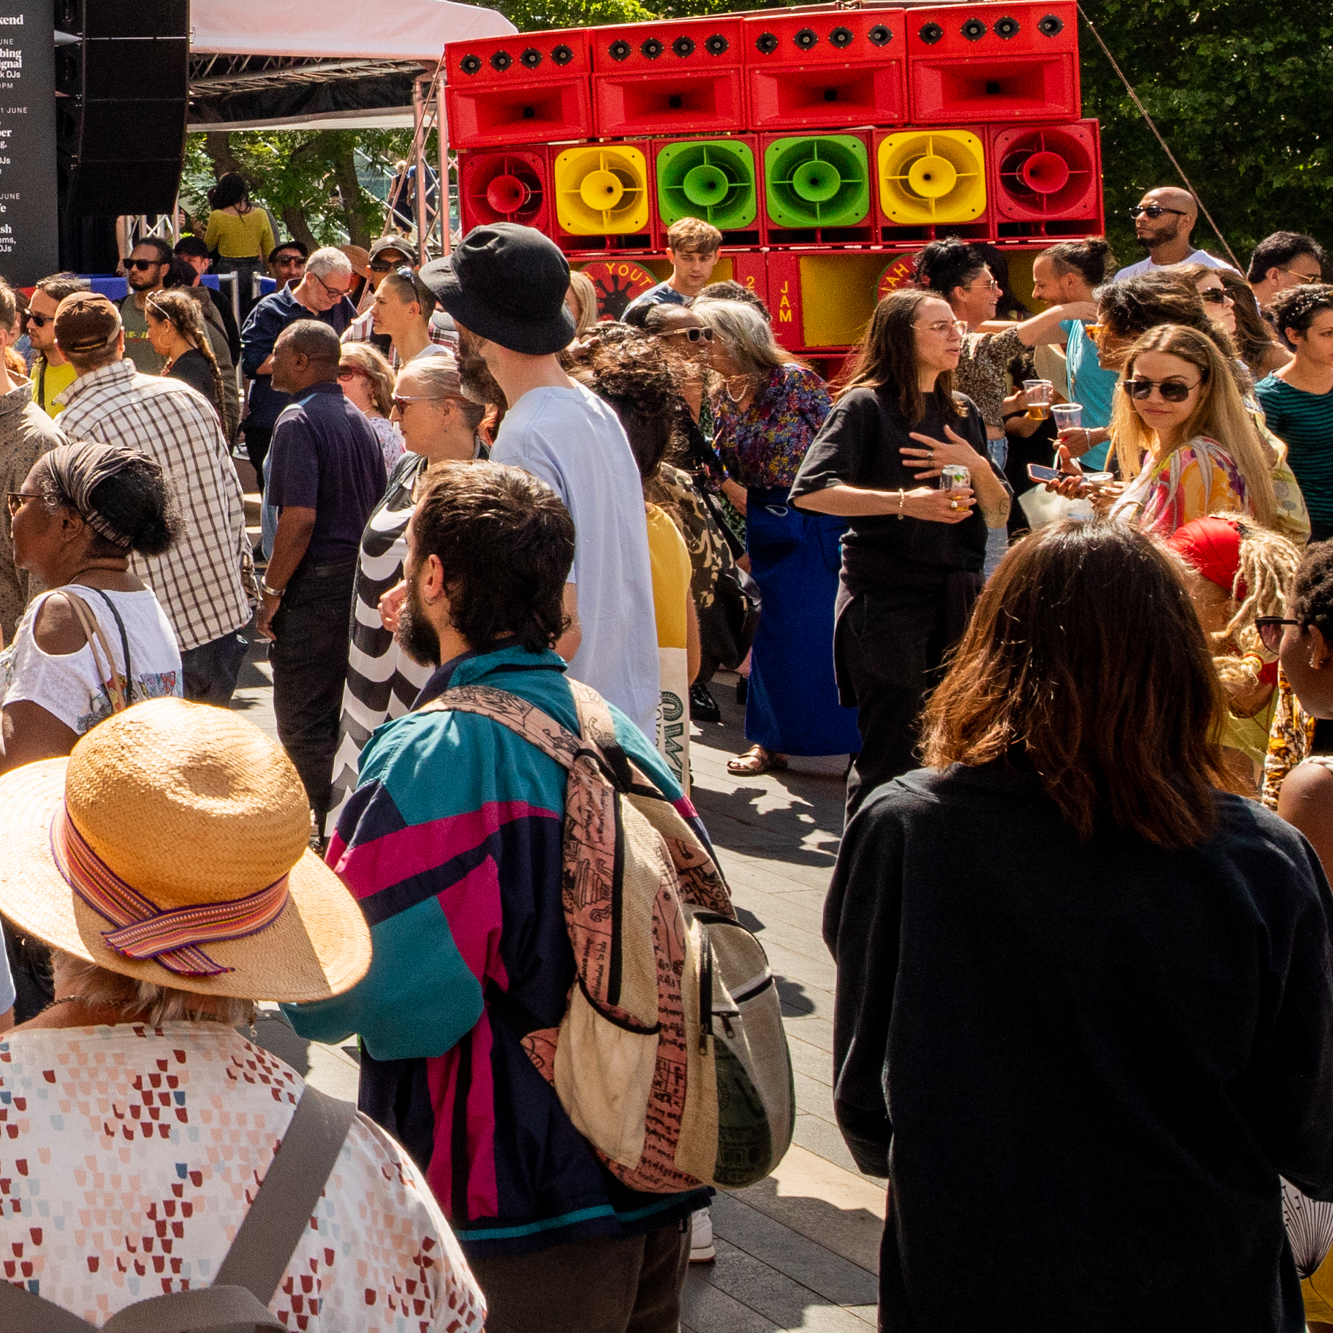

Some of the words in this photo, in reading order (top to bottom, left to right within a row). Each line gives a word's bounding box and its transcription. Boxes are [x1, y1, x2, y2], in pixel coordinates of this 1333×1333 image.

[6, 70, 20, 78] DJs
[605, 262, 652, 287] YOUT
[779, 281, 792, 322] JAM
